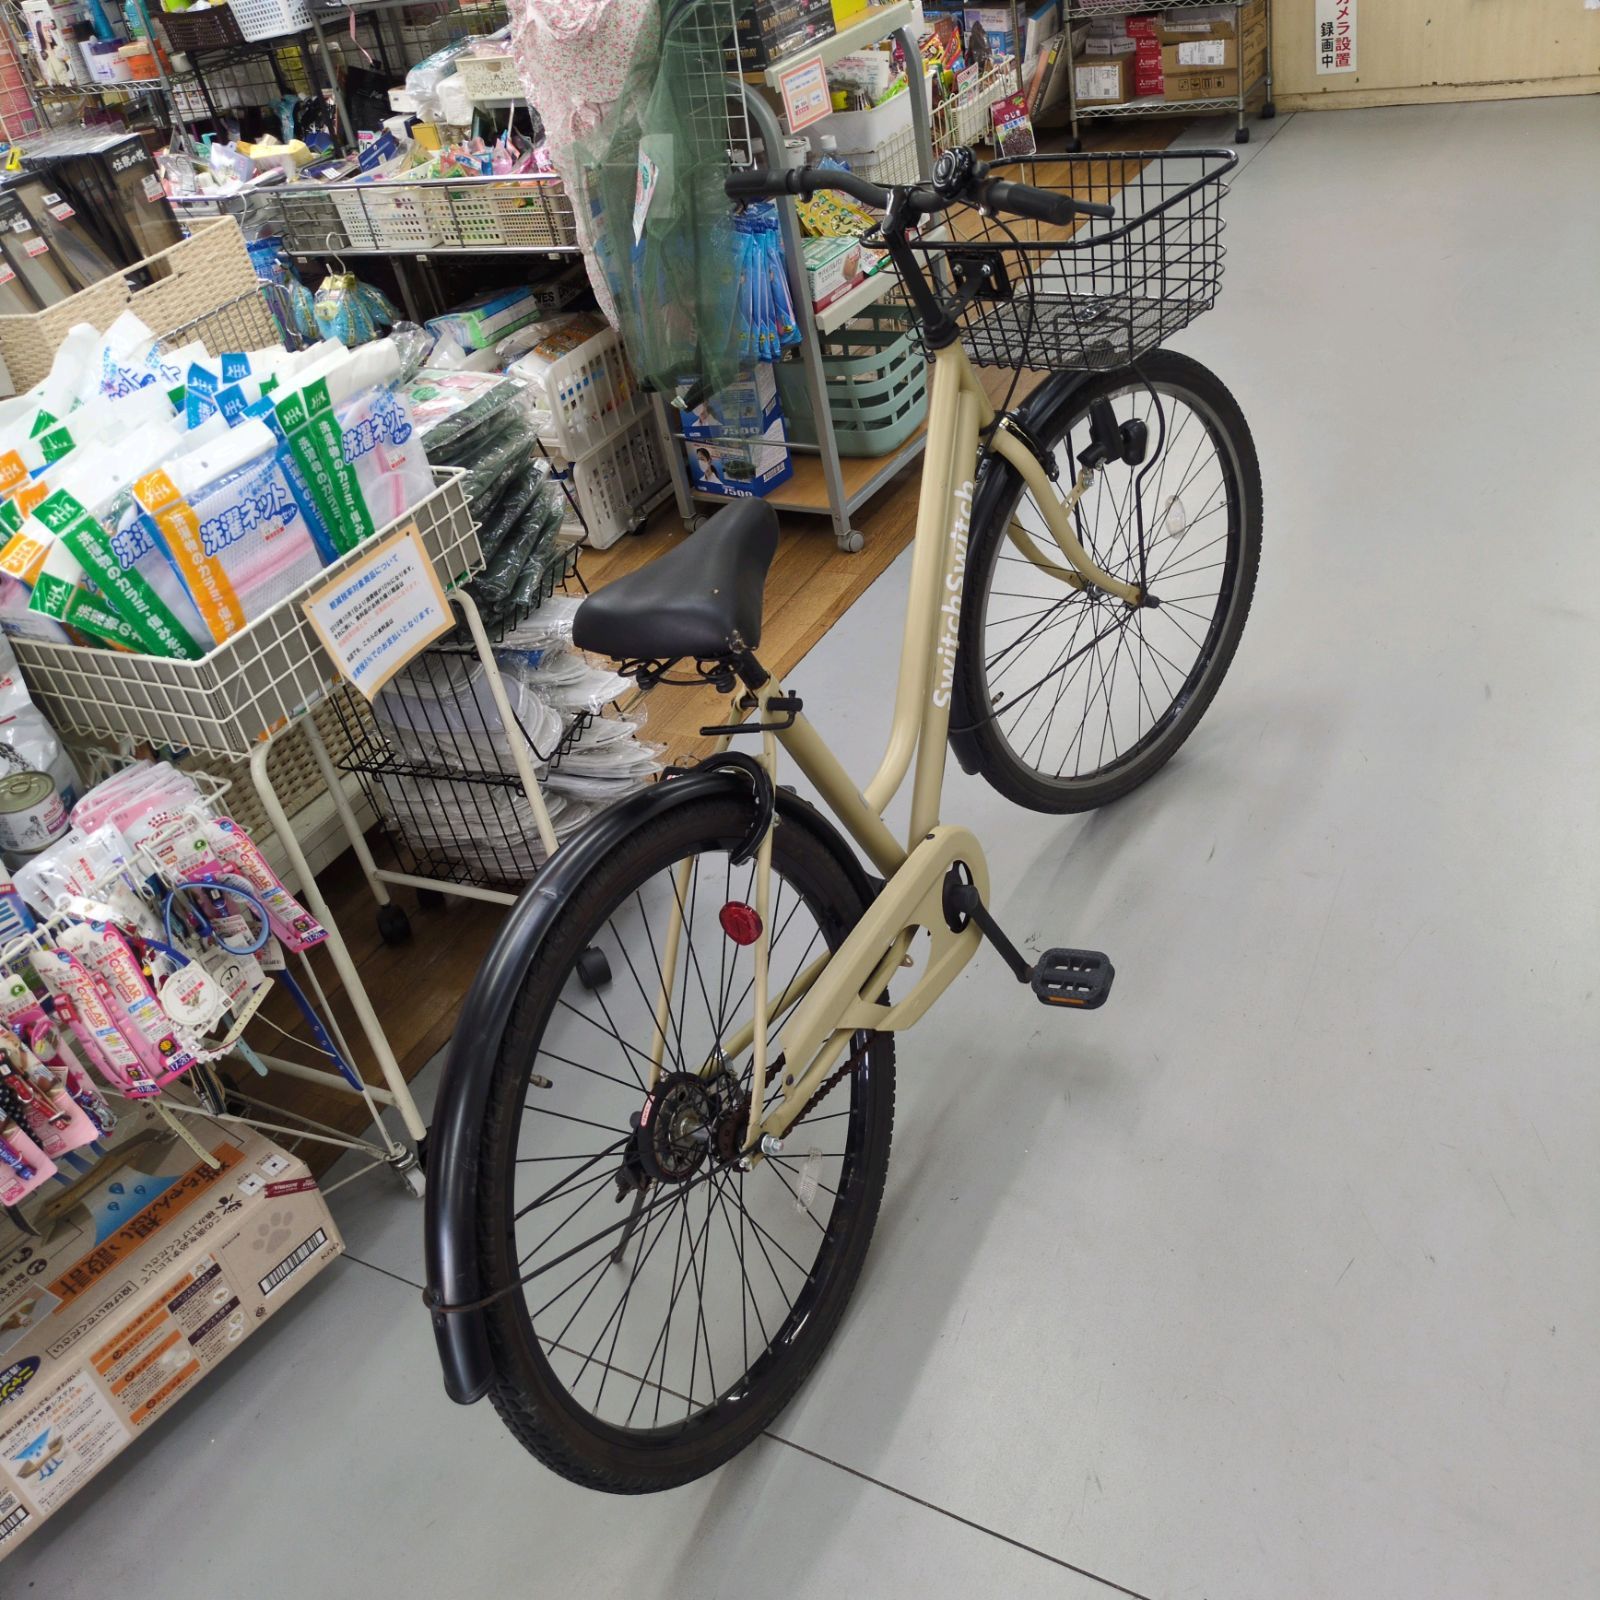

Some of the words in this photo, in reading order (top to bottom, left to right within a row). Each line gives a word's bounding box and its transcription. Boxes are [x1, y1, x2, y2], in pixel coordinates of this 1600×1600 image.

[1320, 21, 1334, 68] 録画中
[342, 402, 404, 463] 洗濯ネット
[198, 483, 285, 556] 洗濯ネット
[169, 512, 237, 635] 洗濯物のカラミ・傷み
[328, 554, 399, 610] 軽減税率対象商品について
[933, 480, 975, 709] SwitchSwitch
[239, 852, 271, 889] COLLAR
[76, 985, 107, 1027] COLLAR
[108, 957, 141, 1000] COLLAR
[139, 1215, 221, 1285] この面を必ず上にして
[140, 1209, 215, 1273] 積み上げてください
[51, 1285, 132, 1352] 投げないでください
